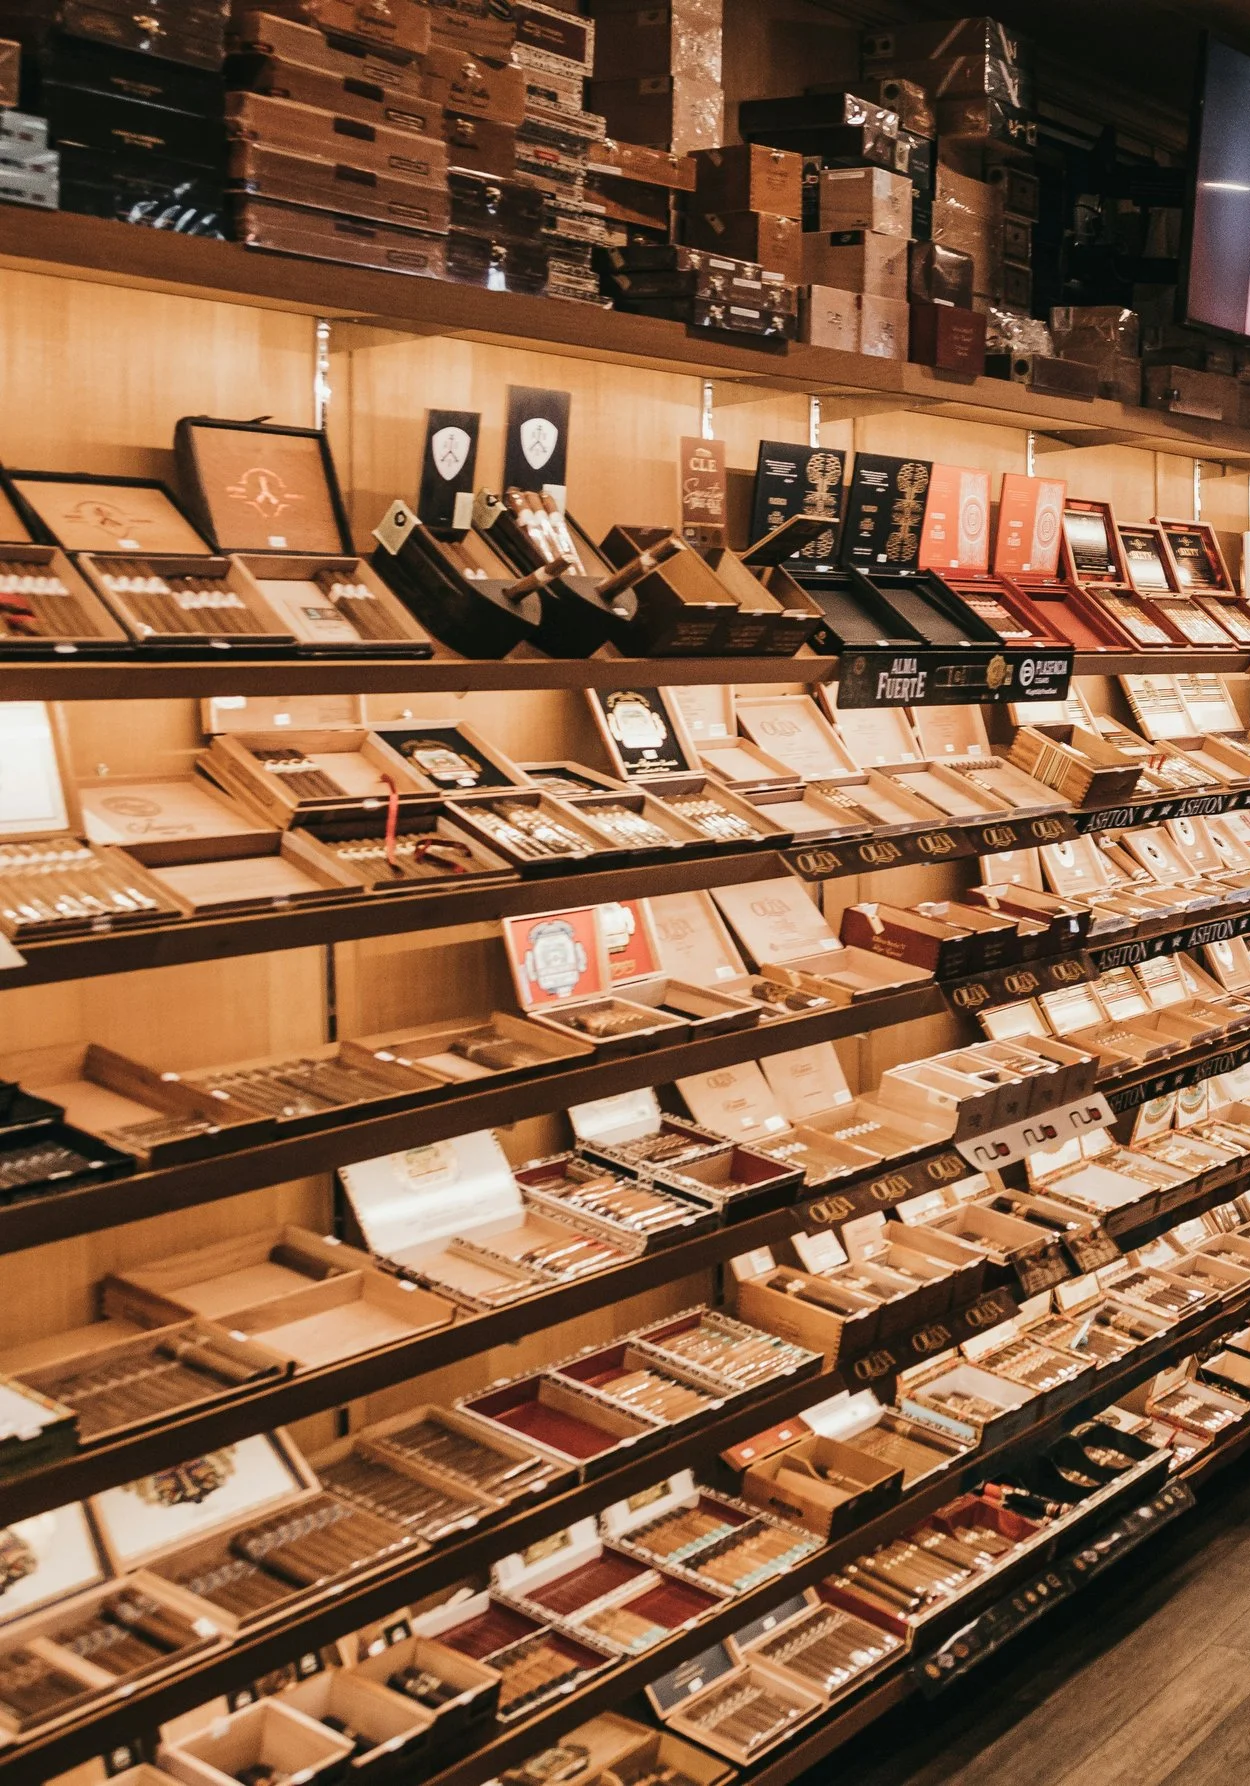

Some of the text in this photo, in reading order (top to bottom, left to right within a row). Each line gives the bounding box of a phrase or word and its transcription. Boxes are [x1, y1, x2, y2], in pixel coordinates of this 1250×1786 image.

[892, 658, 917, 674] ALMA
[876, 672, 928, 702] FUERTE
[1086, 807, 1139, 830] ASHTON
[1175, 796, 1227, 817] ASHTON
[1099, 941, 1150, 969] ASHTON
[1188, 919, 1236, 947] ASHTON
[1193, 1053, 1237, 1082] ASHTON
